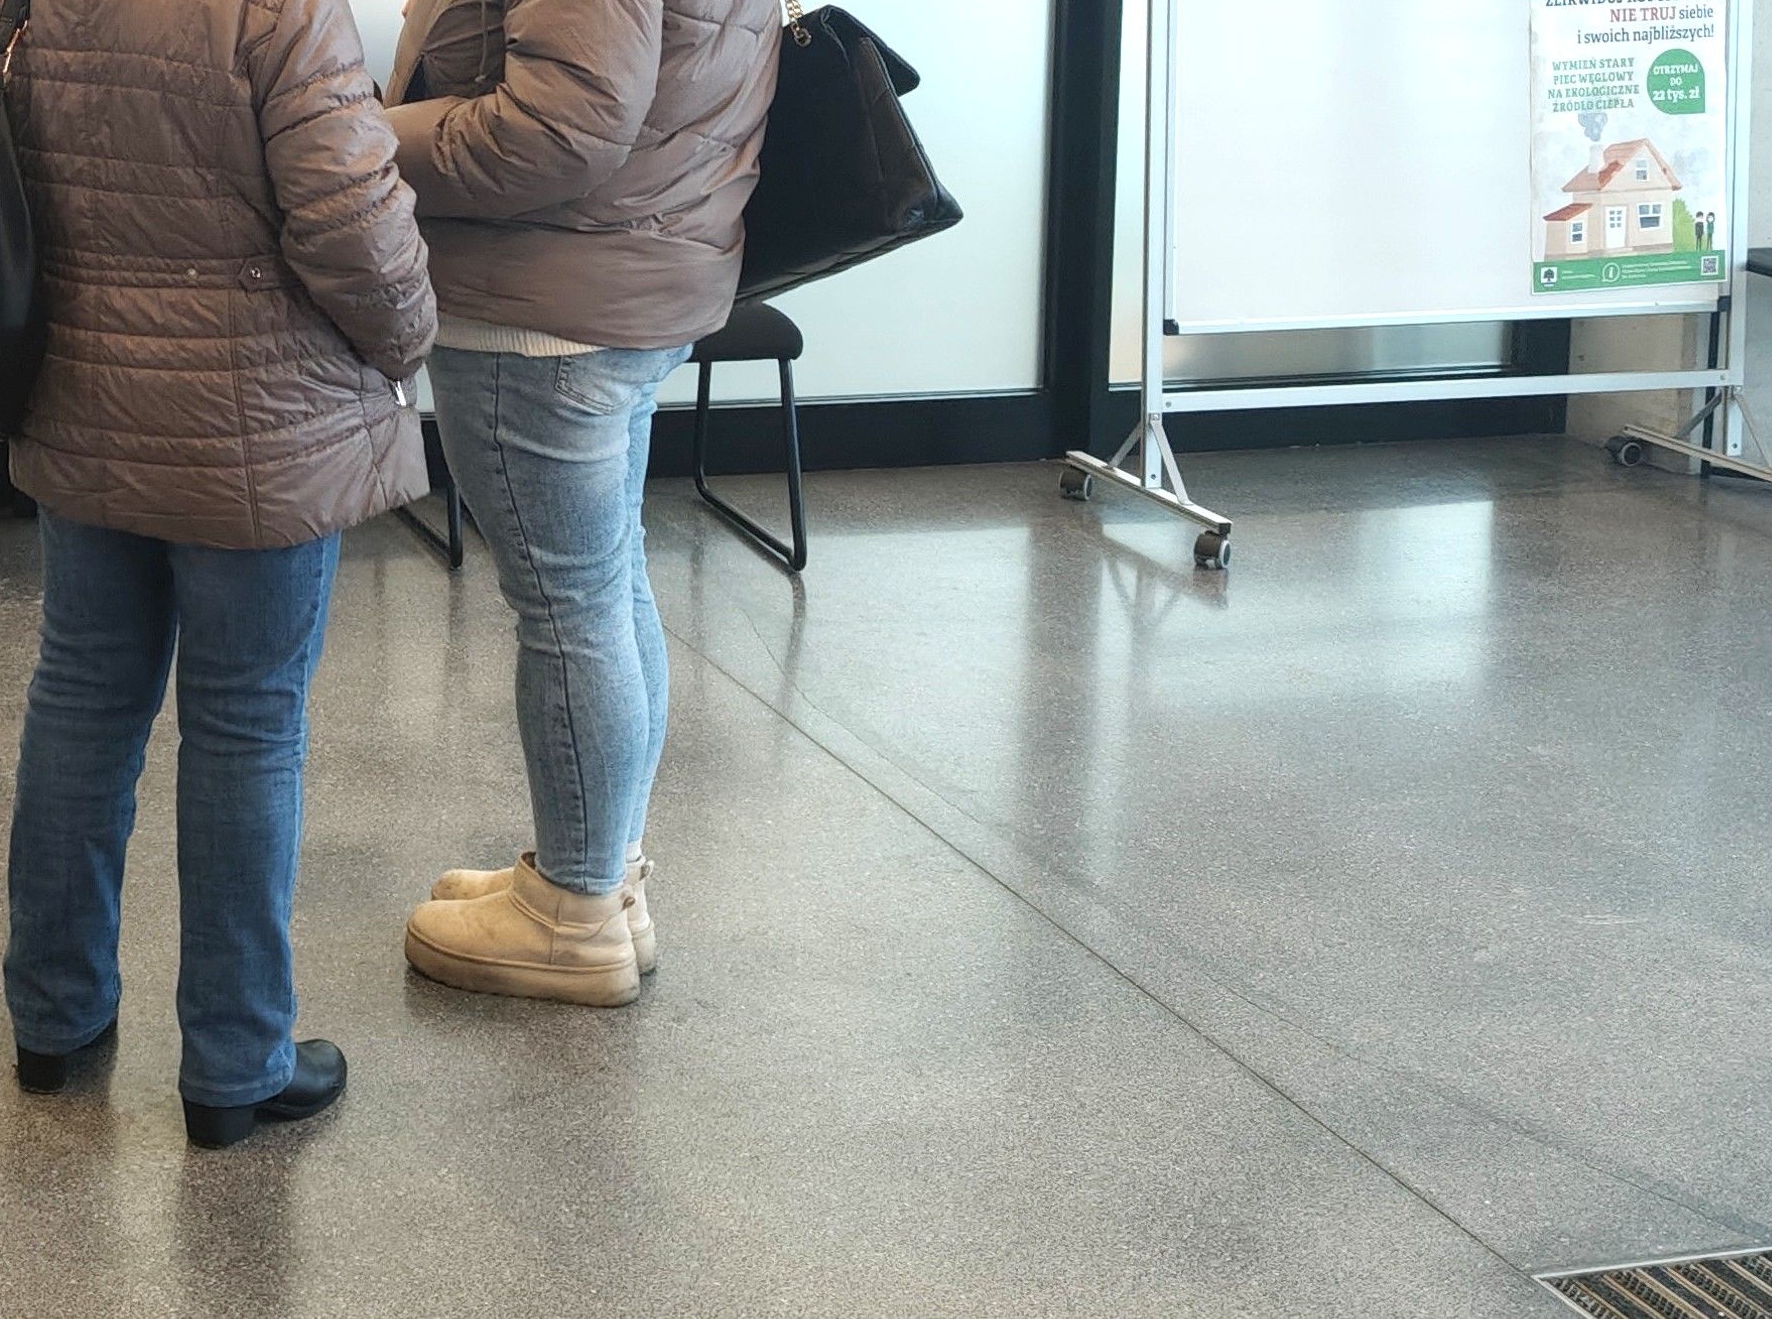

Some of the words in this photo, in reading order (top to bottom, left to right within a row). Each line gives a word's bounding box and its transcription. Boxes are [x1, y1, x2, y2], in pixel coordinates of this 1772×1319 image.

[1610, 8, 1637, 23] NIE
[1640, 6, 1677, 21] TRUJ
[1679, 4, 1714, 20] siebie
[1577, 29, 1582, 44] i
[1584, 27, 1630, 44] swoich
[1633, 24, 1715, 45] najbliższych!
[1552, 58, 1597, 71] WYMIEŃ
[1599, 57, 1636, 68] STARY
[1653, 63, 1699, 76] OTRZYMAJ
[1553, 74, 1577, 85] PIEC
[1578, 71, 1634, 85] WĘGLOWY
[1670, 77, 1683, 87] DO
[1547, 88, 1563, 100] NA
[1565, 84, 1640, 98] EKOLOGICZNE
[1652, 90, 1666, 101] 22
[1667, 88, 1688, 103] tys.
[1688, 86, 1700, 100] zł
[1552, 100, 1594, 113] ŹRÓDŁO
[1596, 97, 1635, 110] CIEPŁA
